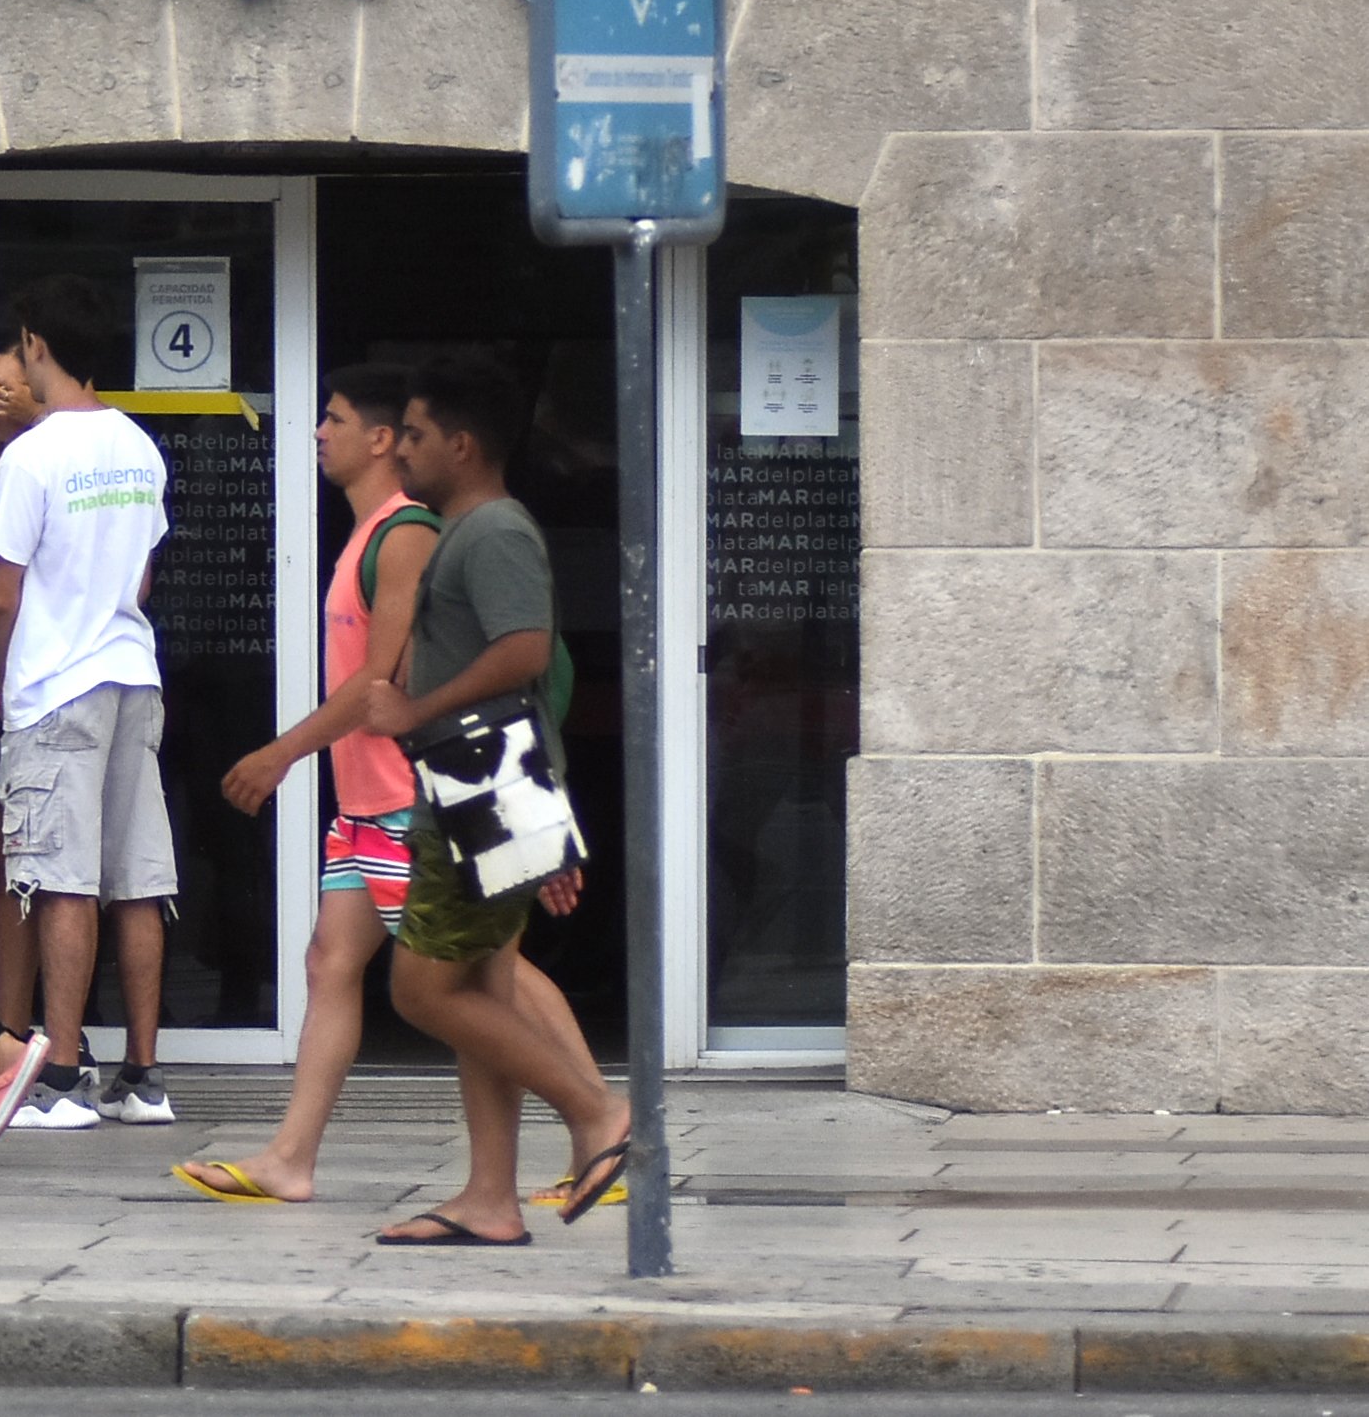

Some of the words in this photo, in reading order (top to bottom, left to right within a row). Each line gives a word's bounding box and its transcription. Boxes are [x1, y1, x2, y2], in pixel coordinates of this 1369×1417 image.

[150, 284, 215, 294] CAPACIDAD
[153, 295, 213, 305] PERMITIDA
[169, 323, 195, 359] 4
